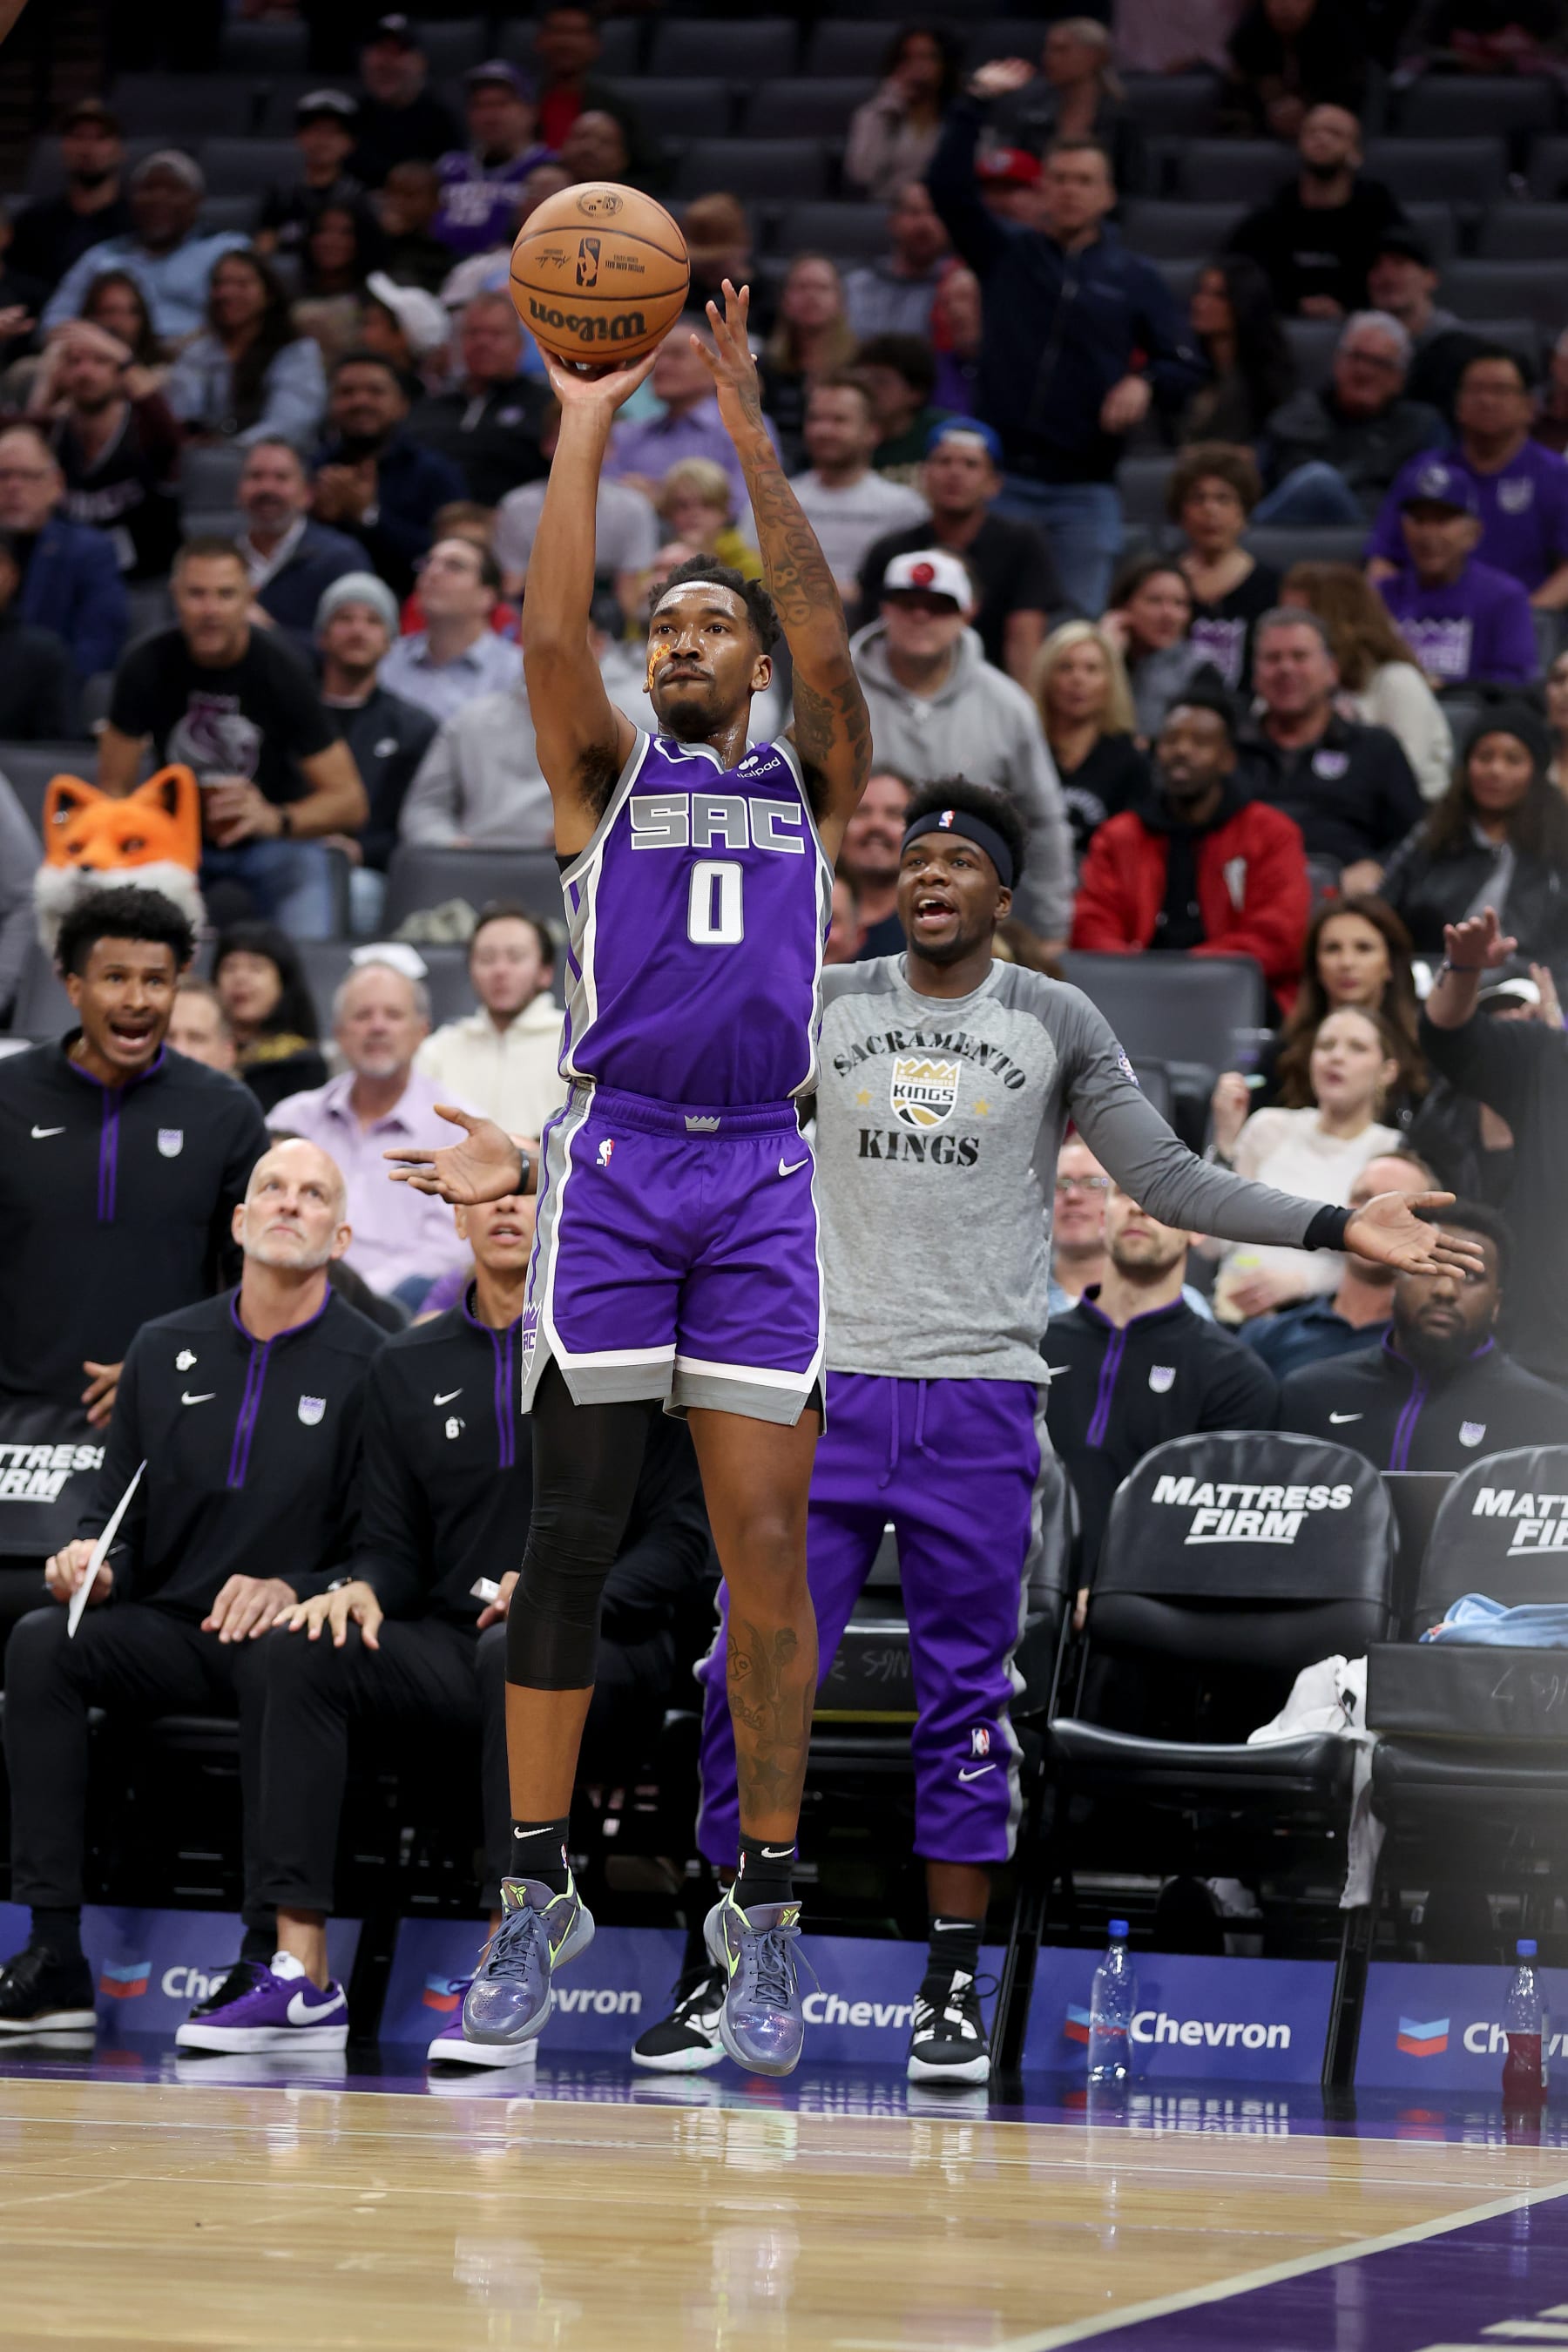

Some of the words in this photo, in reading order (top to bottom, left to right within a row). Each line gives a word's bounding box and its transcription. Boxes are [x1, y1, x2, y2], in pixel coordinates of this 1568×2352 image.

[530, 297, 647, 341] Wilson
[629, 793, 805, 855] SAC
[687, 859, 744, 945] 0
[833, 1030, 1026, 1090] SACRAMENTO
[893, 1084, 955, 1102] KINGS
[857, 1128, 980, 1167] KINGS
[1152, 1475, 1354, 1511] MATTRESS
[1190, 1508, 1304, 1537] FIRM
[551, 1987, 642, 2014] vron
[802, 1992, 916, 2028] Chevr
[1132, 2011, 1291, 2049] Chevron
